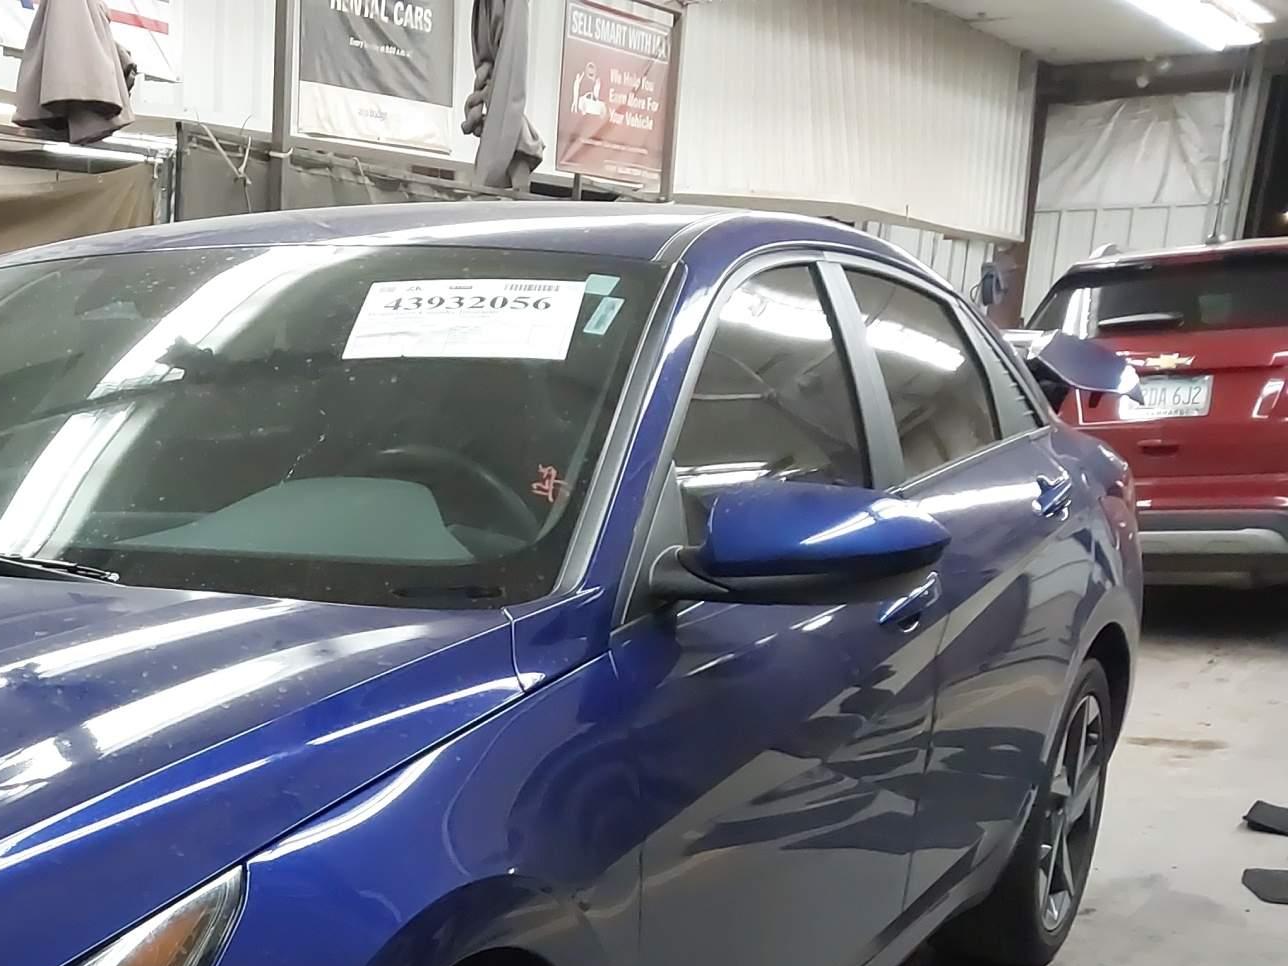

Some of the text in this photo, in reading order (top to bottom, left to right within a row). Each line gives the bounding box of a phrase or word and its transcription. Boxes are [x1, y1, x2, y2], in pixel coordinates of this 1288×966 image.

[393, 1, 433, 33] CARS
[572, 10, 593, 38] SELL
[594, 17, 628, 47] SMART
[628, 26, 652, 55] WITH
[647, 96, 660, 112] For
[625, 111, 653, 130] Vehicle
[383, 295, 553, 311] 43932056
[1173, 385, 1202, 406] 6J2
